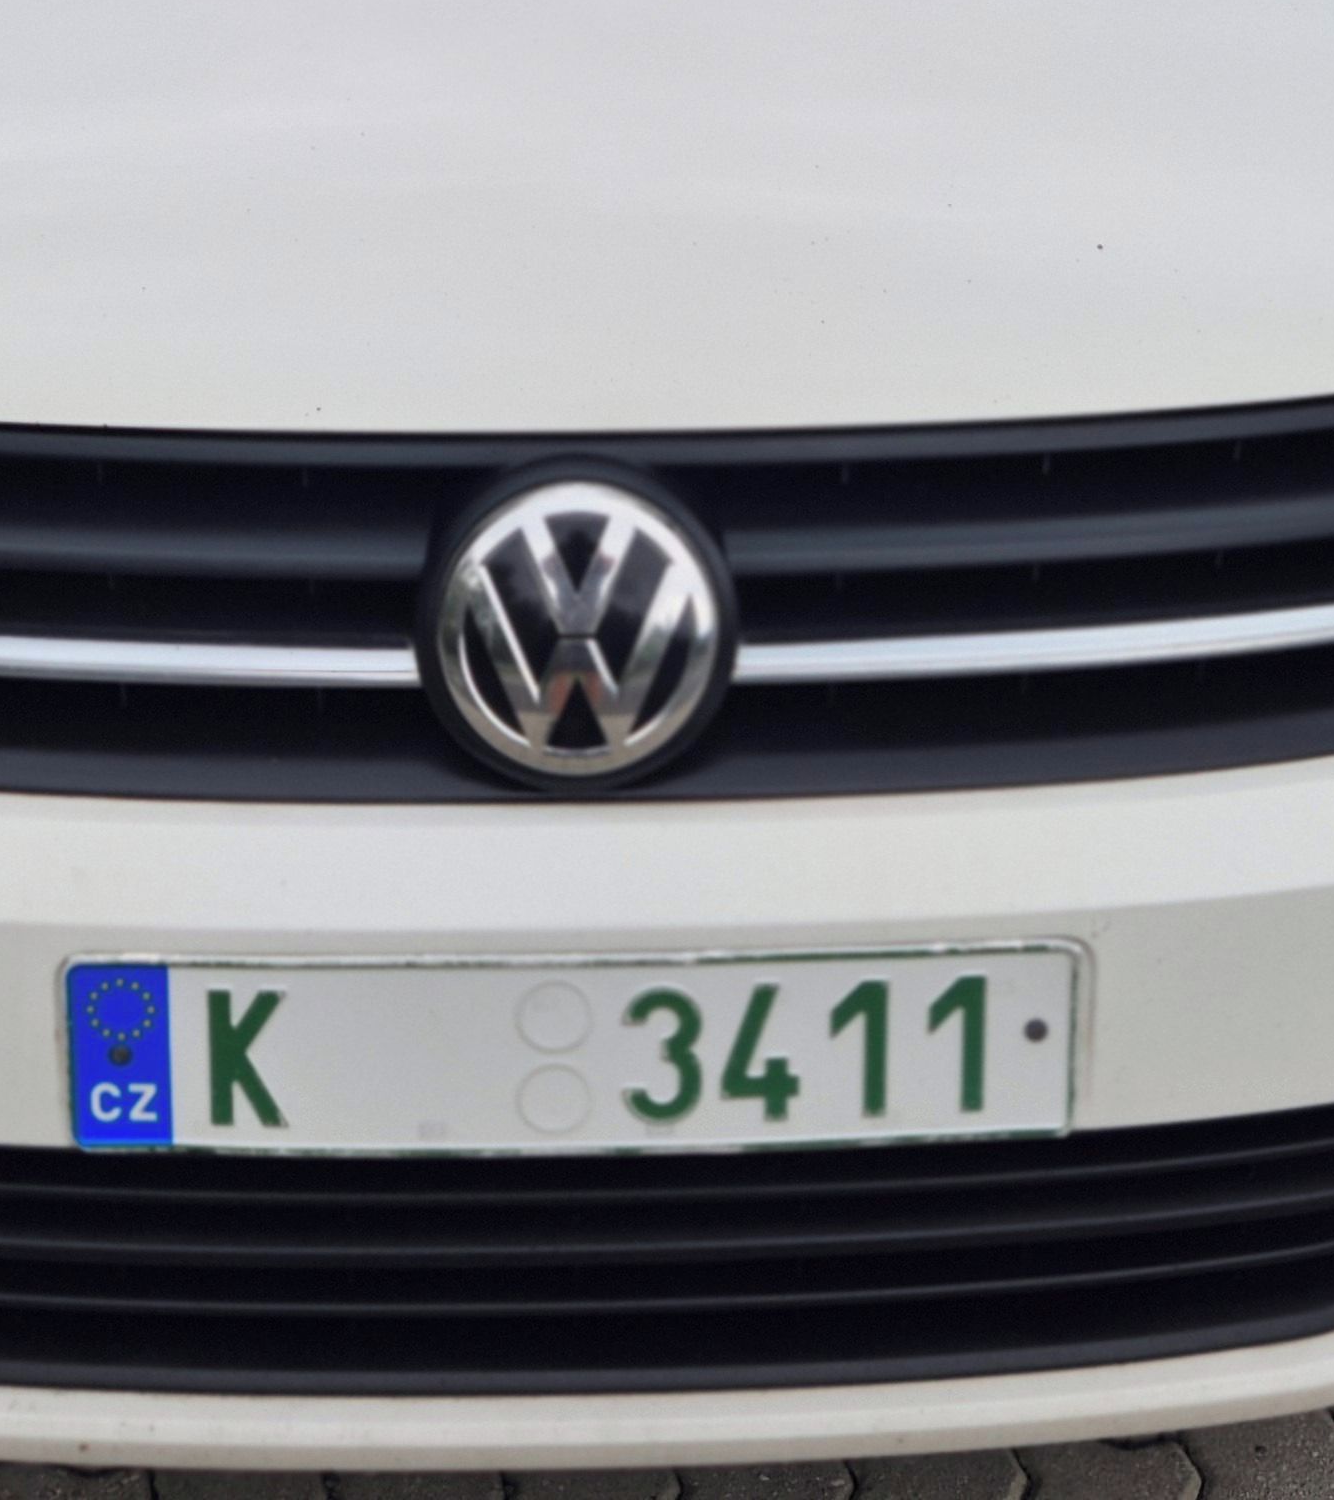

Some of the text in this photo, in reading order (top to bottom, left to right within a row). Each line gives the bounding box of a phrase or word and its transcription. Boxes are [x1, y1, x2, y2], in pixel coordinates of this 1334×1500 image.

[441, 484, 716, 775] VW
[90, 1082, 158, 1122] CZ
[206, 975, 988, 1129] K 3411
